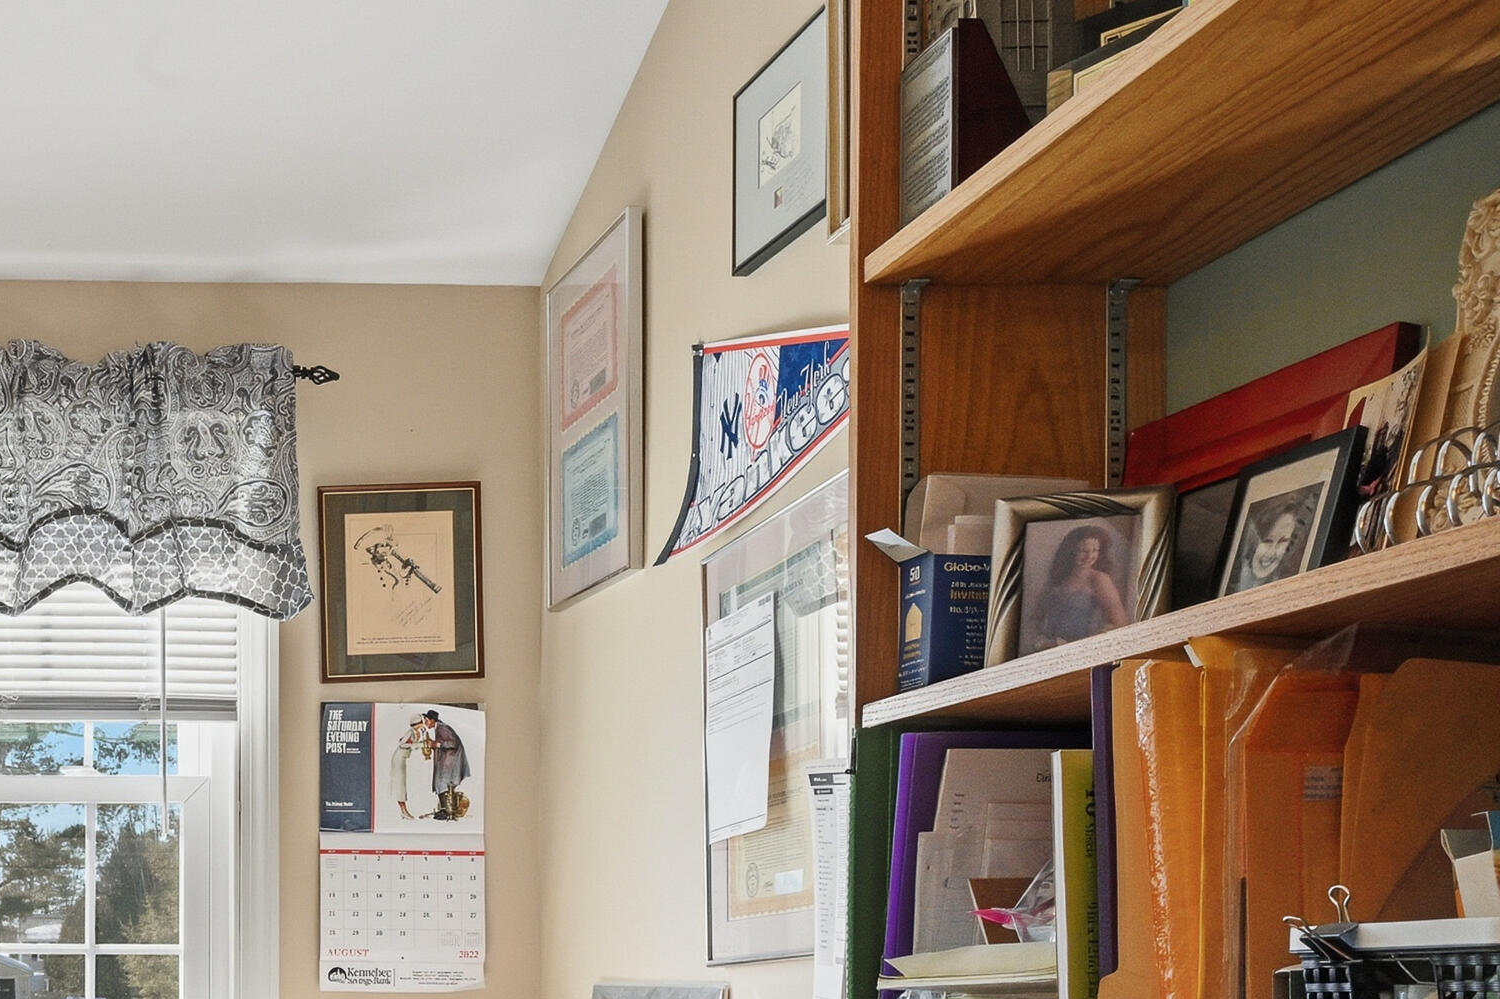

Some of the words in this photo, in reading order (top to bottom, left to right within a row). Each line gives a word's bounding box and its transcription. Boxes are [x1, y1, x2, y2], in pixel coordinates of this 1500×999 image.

[326, 720, 369, 732] SATURDAY
[326, 731, 360, 743] EVENING
[325, 742, 347, 754] POST
[327, 949, 370, 958] AUGUST
[459, 951, 479, 959] 2022
